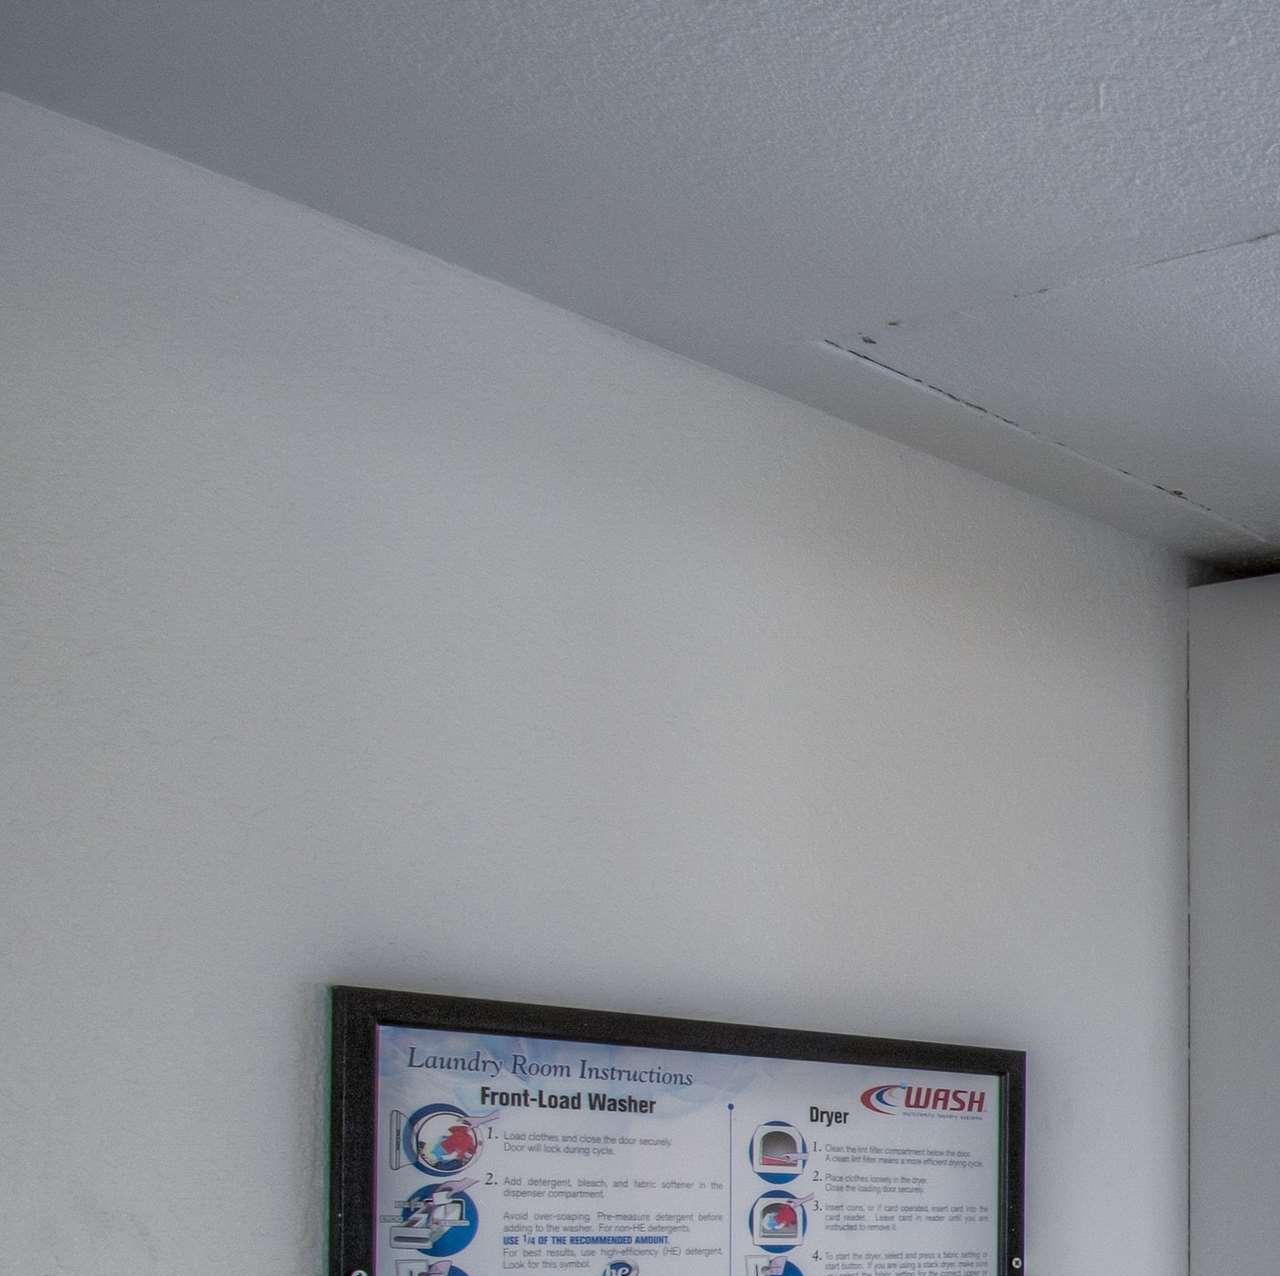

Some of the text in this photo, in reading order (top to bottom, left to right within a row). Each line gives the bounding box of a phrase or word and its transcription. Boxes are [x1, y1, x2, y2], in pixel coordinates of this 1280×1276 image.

[407, 1047, 694, 1086] Laundry Room Instructions
[480, 1086, 656, 1114] Front-Load Washer
[904, 1086, 986, 1113] WASH
[809, 1106, 850, 1127] Dryer
